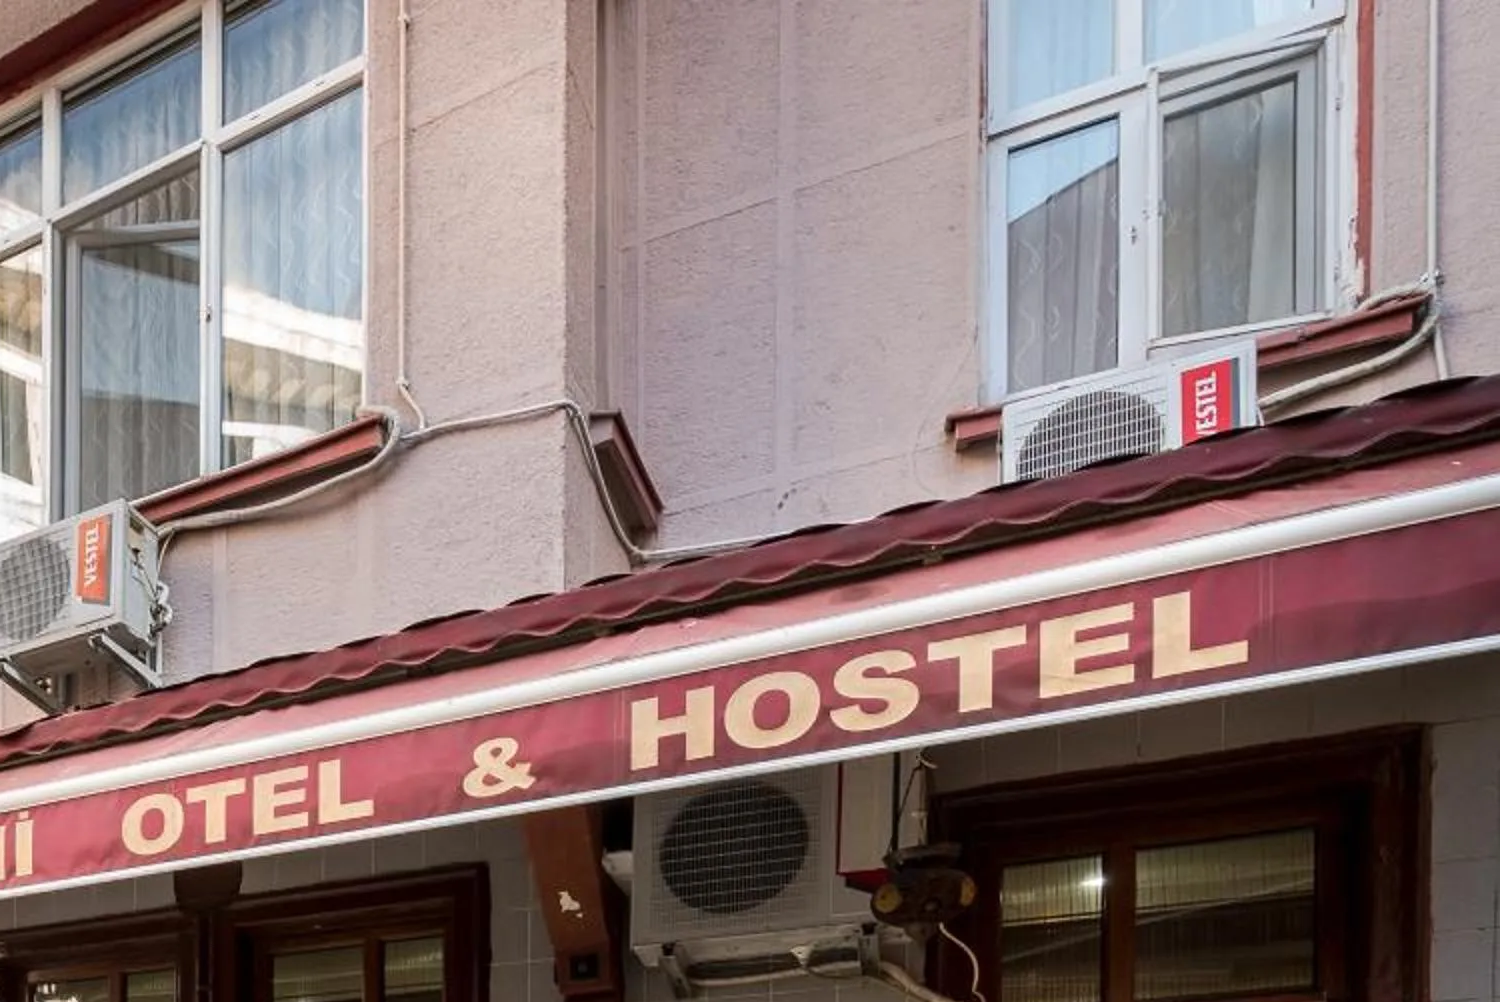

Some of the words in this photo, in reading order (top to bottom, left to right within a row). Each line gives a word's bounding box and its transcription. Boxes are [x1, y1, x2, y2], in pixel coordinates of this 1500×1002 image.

[1195, 369, 1217, 435] ESTEL
[83, 523, 100, 588] VESTEL
[121, 758, 375, 857] OTEL
[462, 736, 536, 800] &
[629, 590, 1249, 772] HOSTEL
